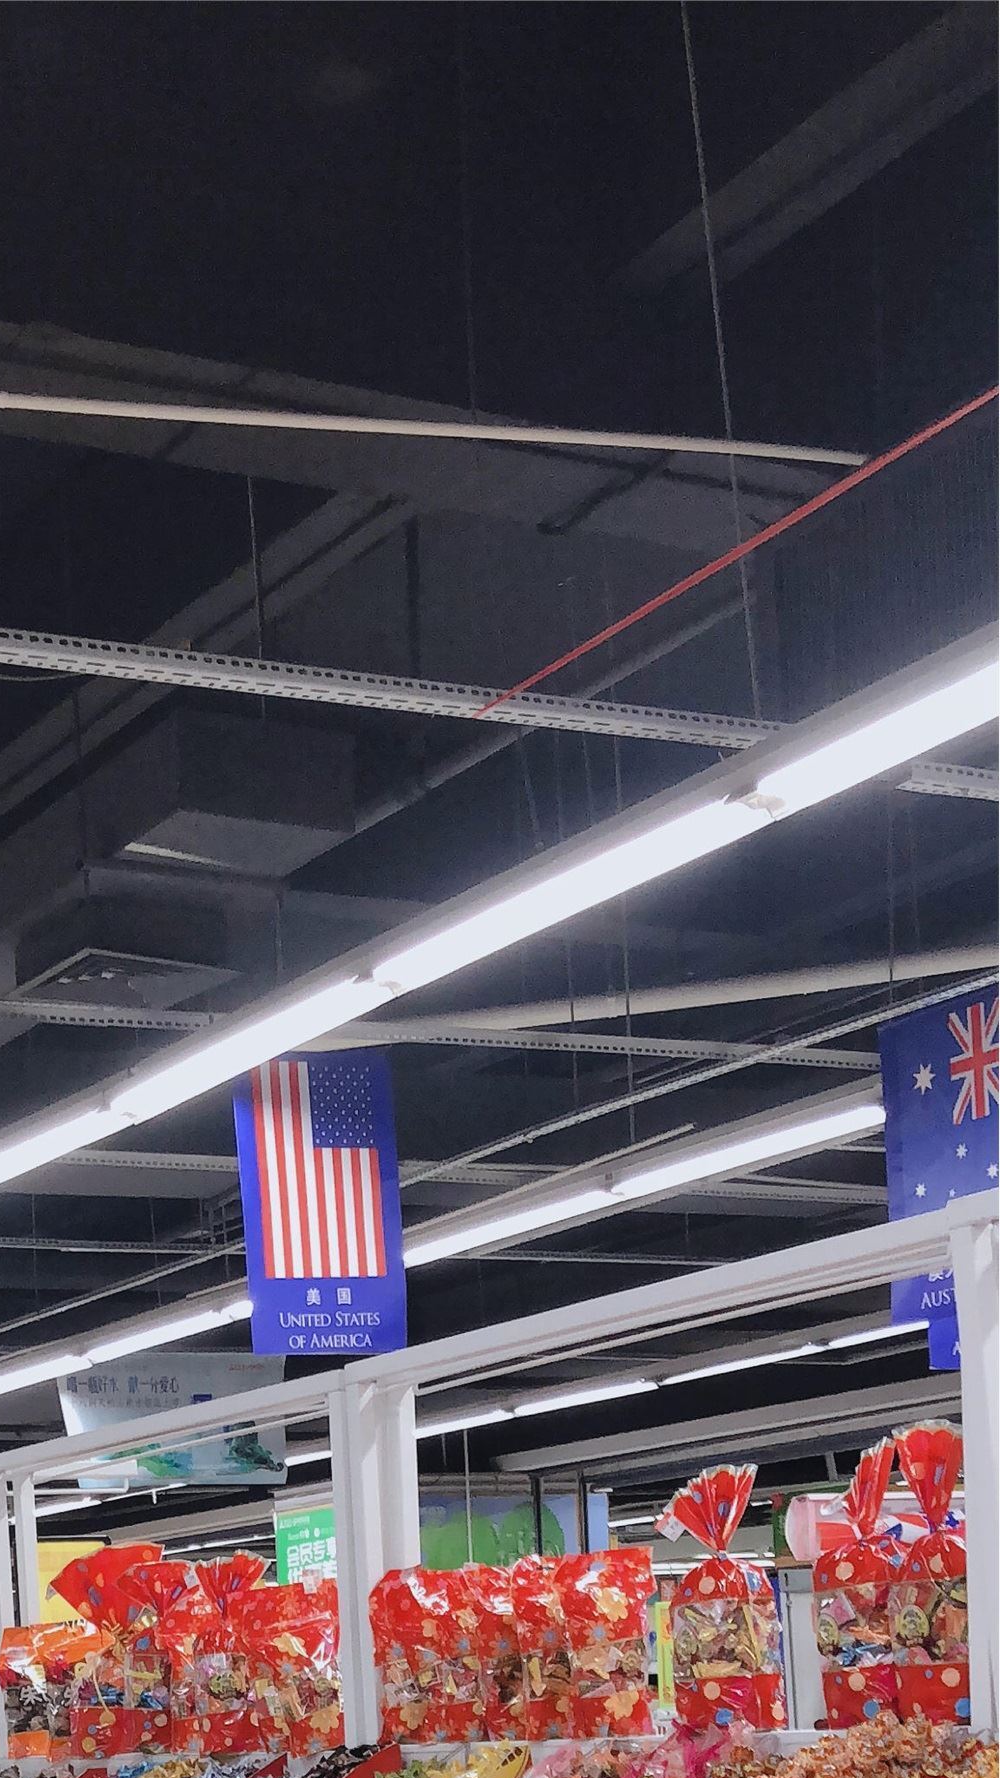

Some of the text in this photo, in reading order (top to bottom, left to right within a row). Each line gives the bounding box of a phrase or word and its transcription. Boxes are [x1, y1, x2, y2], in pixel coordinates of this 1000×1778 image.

[307, 1288, 351, 1306] 美国
[280, 1311, 380, 1328] UNITED STATES
[289, 1333, 373, 1349] OF AMERICA
